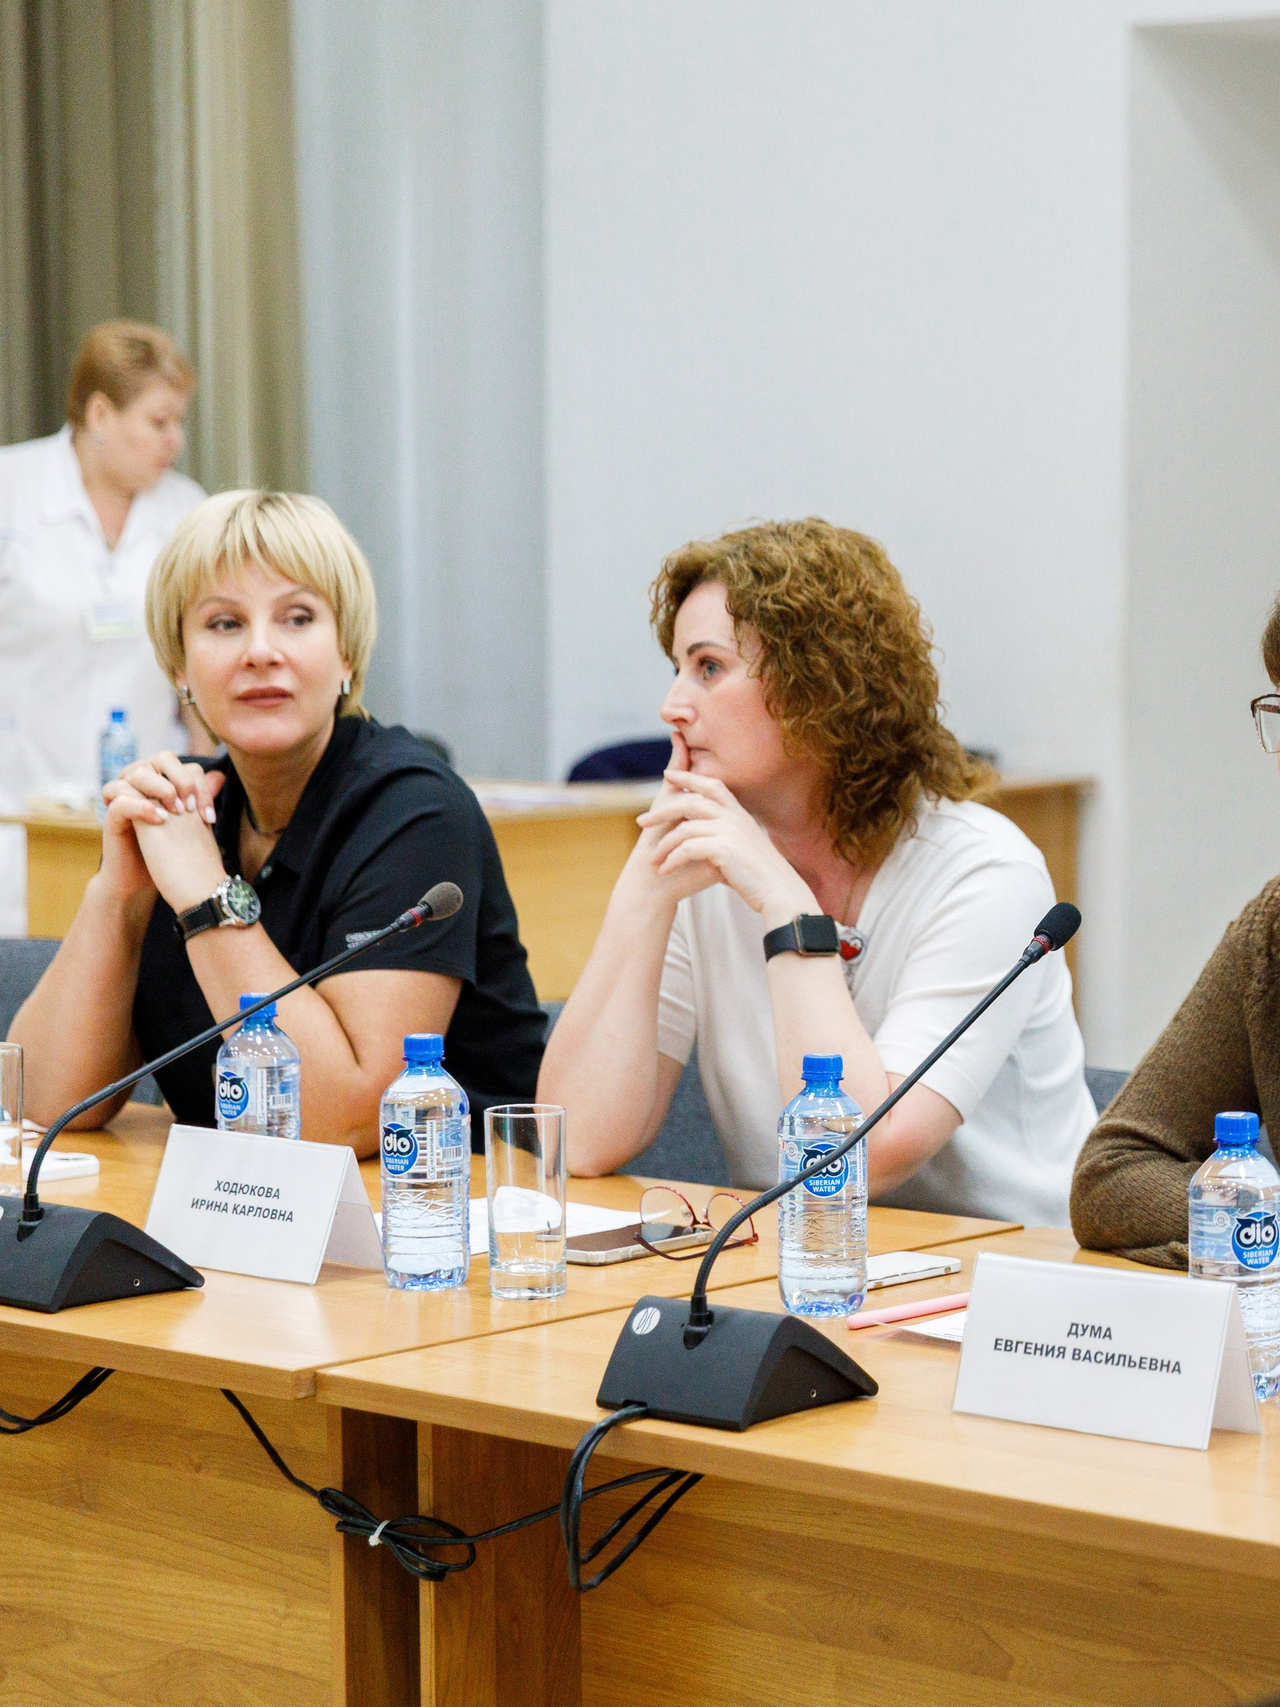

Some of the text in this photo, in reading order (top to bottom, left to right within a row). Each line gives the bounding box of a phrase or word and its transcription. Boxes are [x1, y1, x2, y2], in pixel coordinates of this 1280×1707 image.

[219, 1081, 243, 1100] dio
[384, 1133, 411, 1153] dio
[385, 1156, 409, 1166] SIBERIAN
[387, 1163, 405, 1172] WATER
[214, 1180, 280, 1200] ХОДЮКОВА
[808, 1178, 841, 1187] SIBERIAN
[812, 1185, 837, 1193] WATER
[190, 1198, 294, 1223] ИРИНА КАРЛОВНА
[1240, 1222, 1276, 1246] dio
[1242, 1249, 1274, 1259] SIBERIAN
[1246, 1257, 1270, 1266] WATER
[1066, 1322, 1113, 1341] ДУМА
[993, 1338, 1182, 1375] ЕВГЕНИЯ ВАСИЛЬЕВНА
